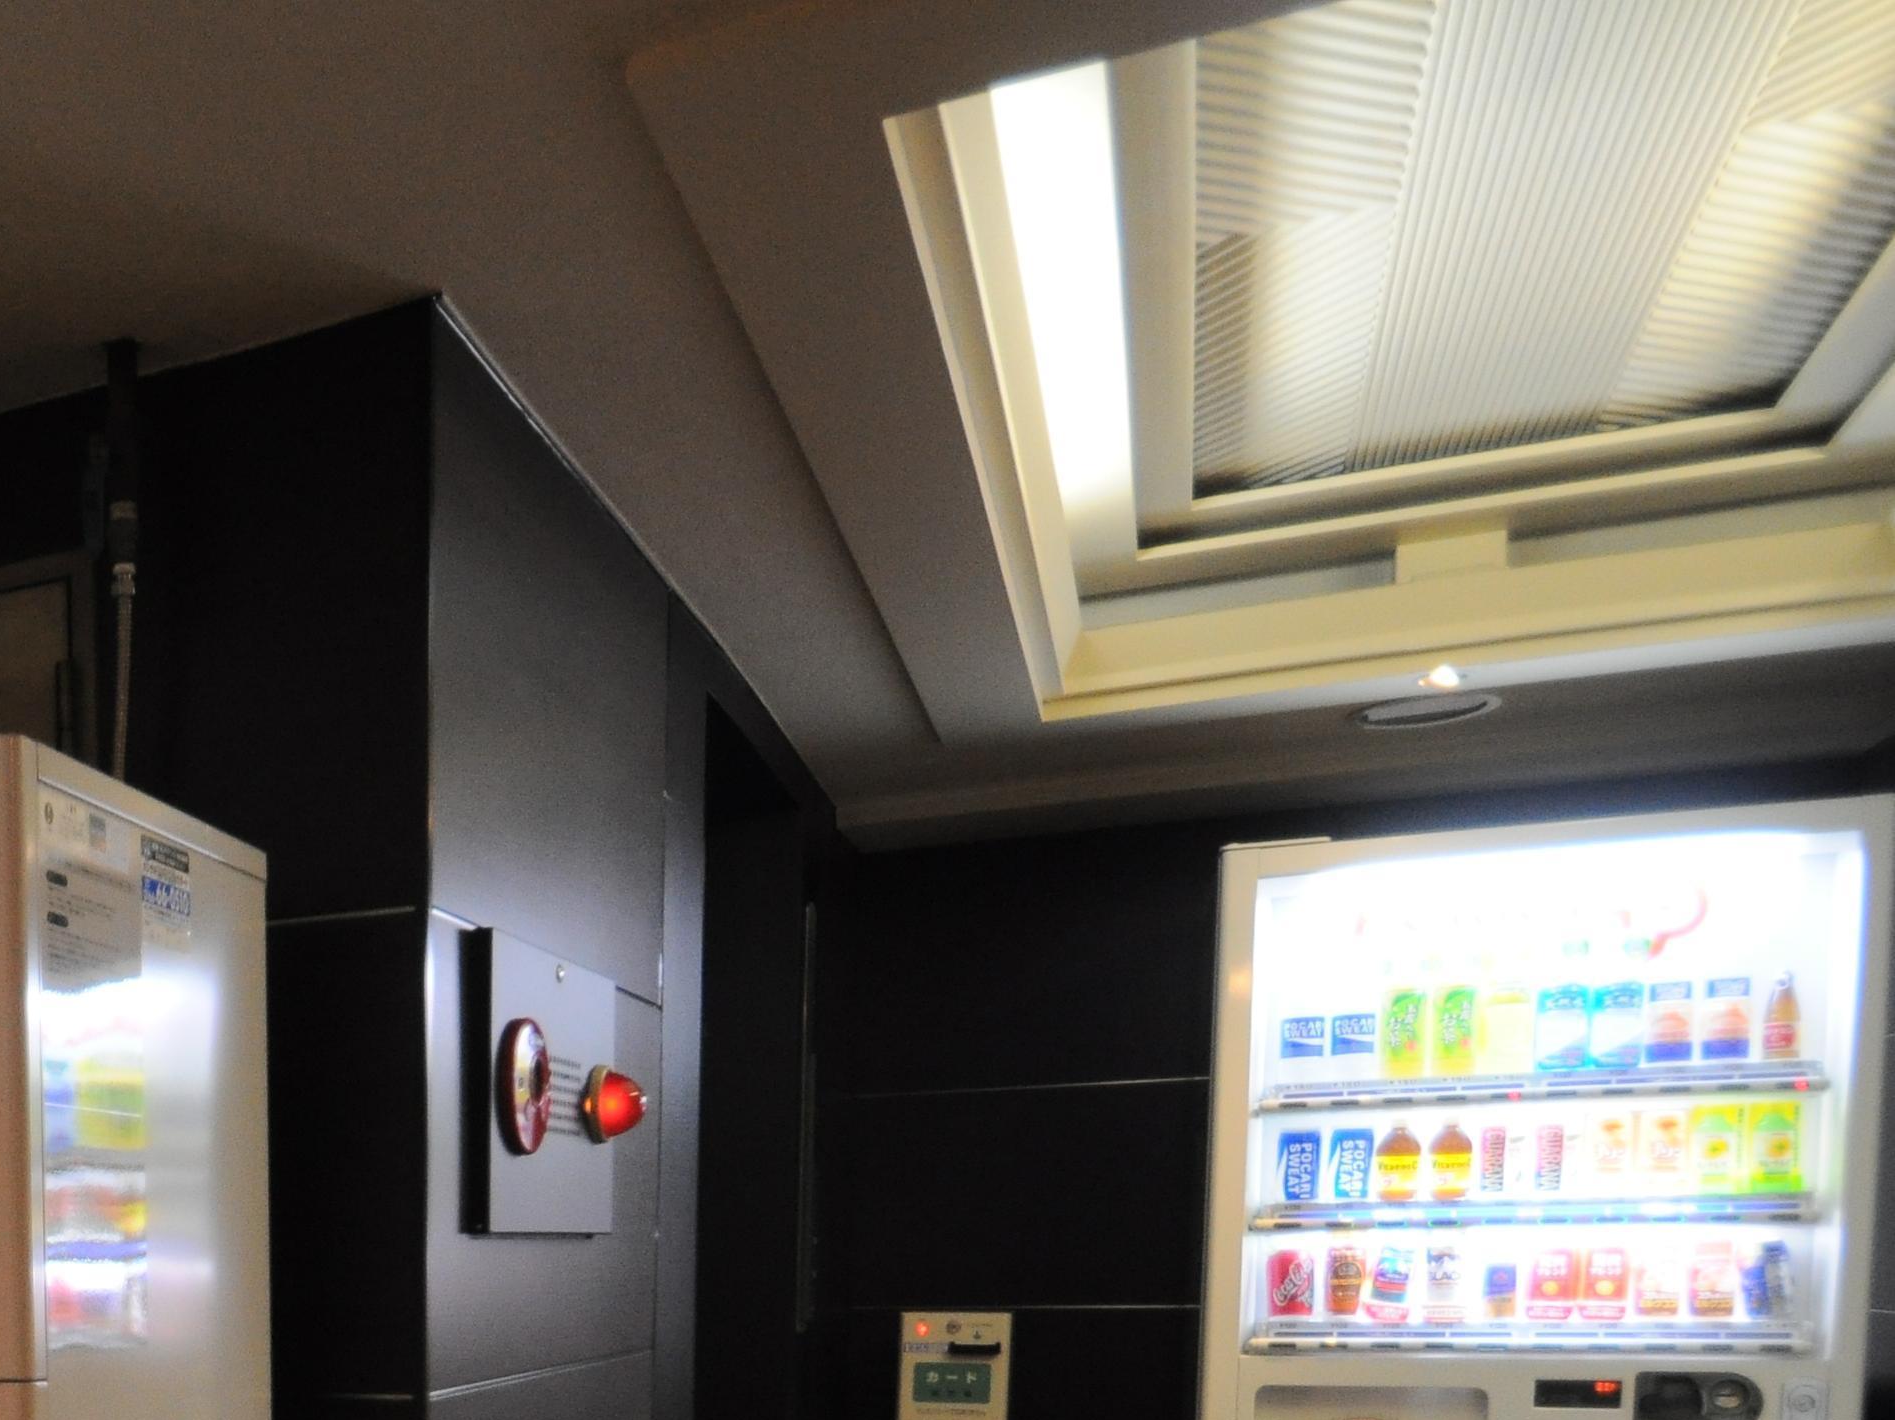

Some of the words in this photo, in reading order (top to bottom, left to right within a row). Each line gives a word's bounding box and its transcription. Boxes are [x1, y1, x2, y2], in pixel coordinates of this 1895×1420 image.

[1287, 1143, 1301, 1196] SWEAT
[1299, 1142, 1313, 1200] POCARI
[1340, 1140, 1354, 1192] SWEAT
[1351, 1139, 1367, 1199] POCARI
